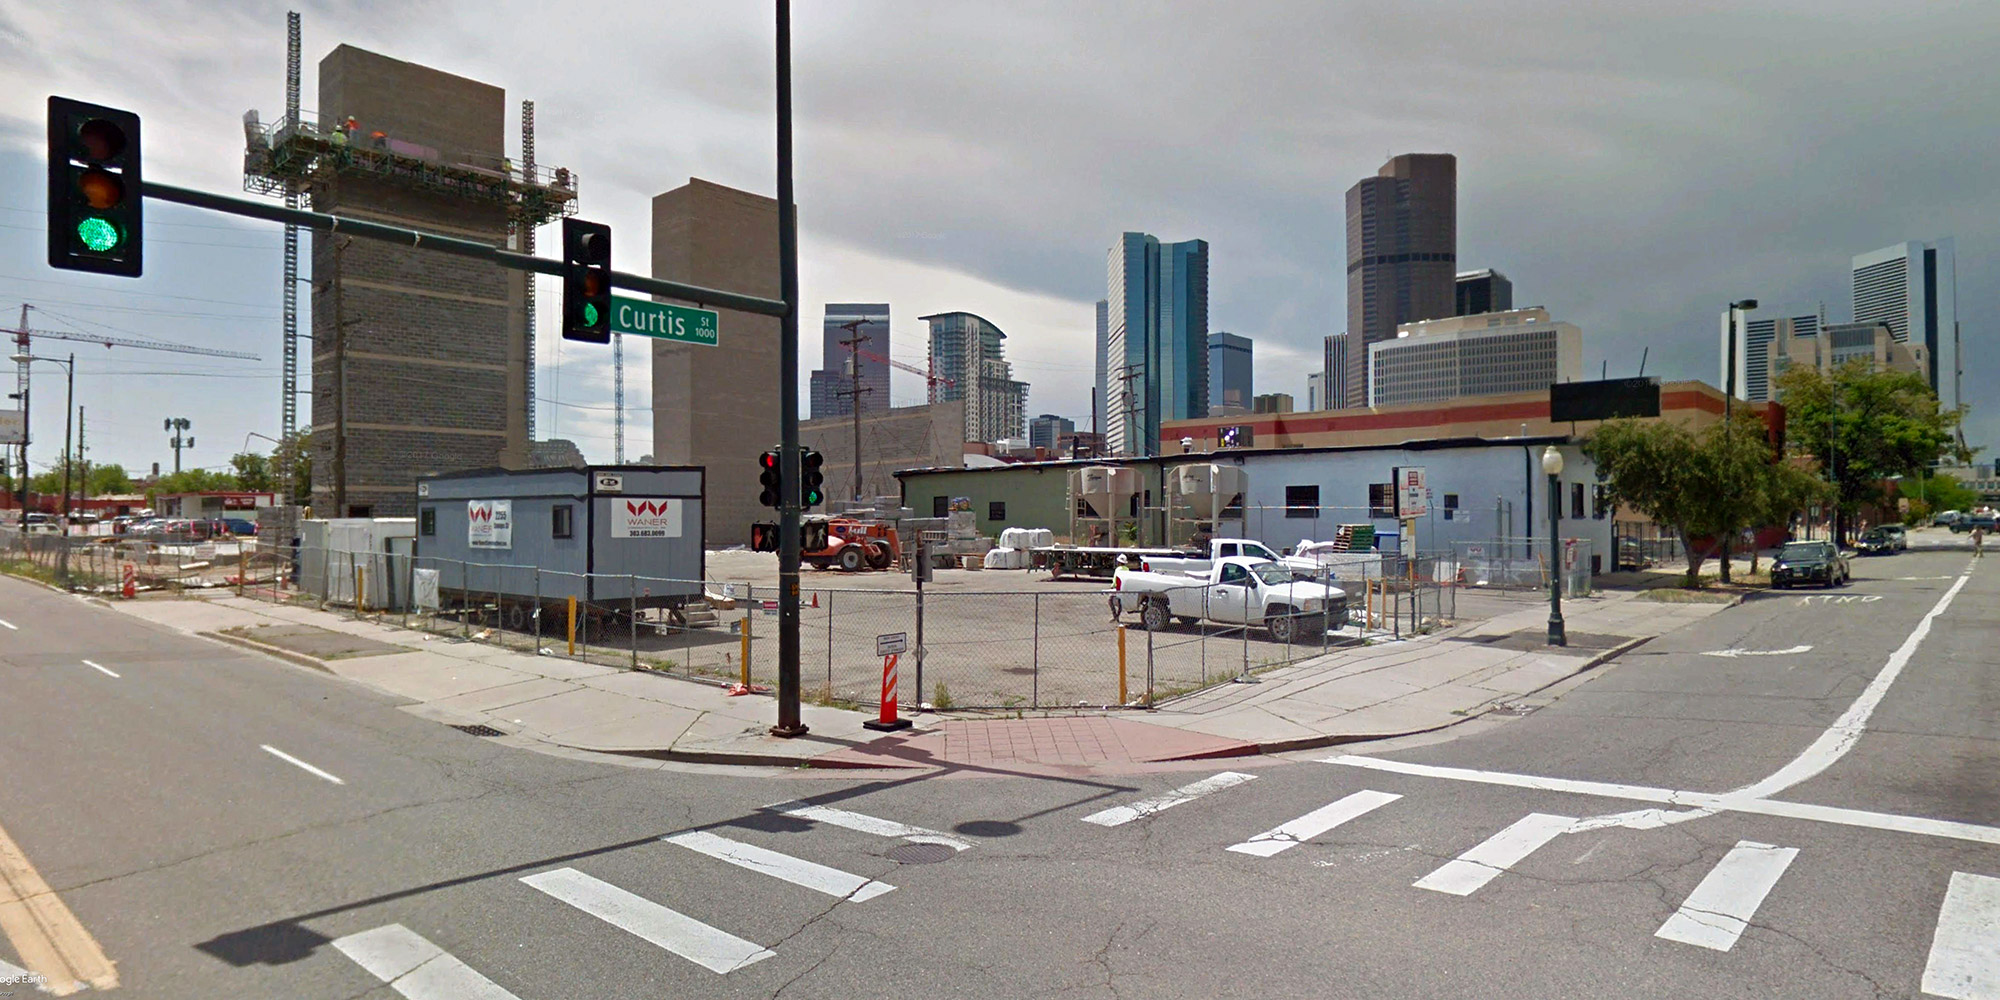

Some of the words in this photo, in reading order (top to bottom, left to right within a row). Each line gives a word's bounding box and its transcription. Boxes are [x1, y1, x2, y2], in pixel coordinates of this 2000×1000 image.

[619, 304, 686, 336] Curtis
[700, 317, 710, 327] St
[695, 327, 715, 339] 1000
[627, 518, 668, 526] WANER
